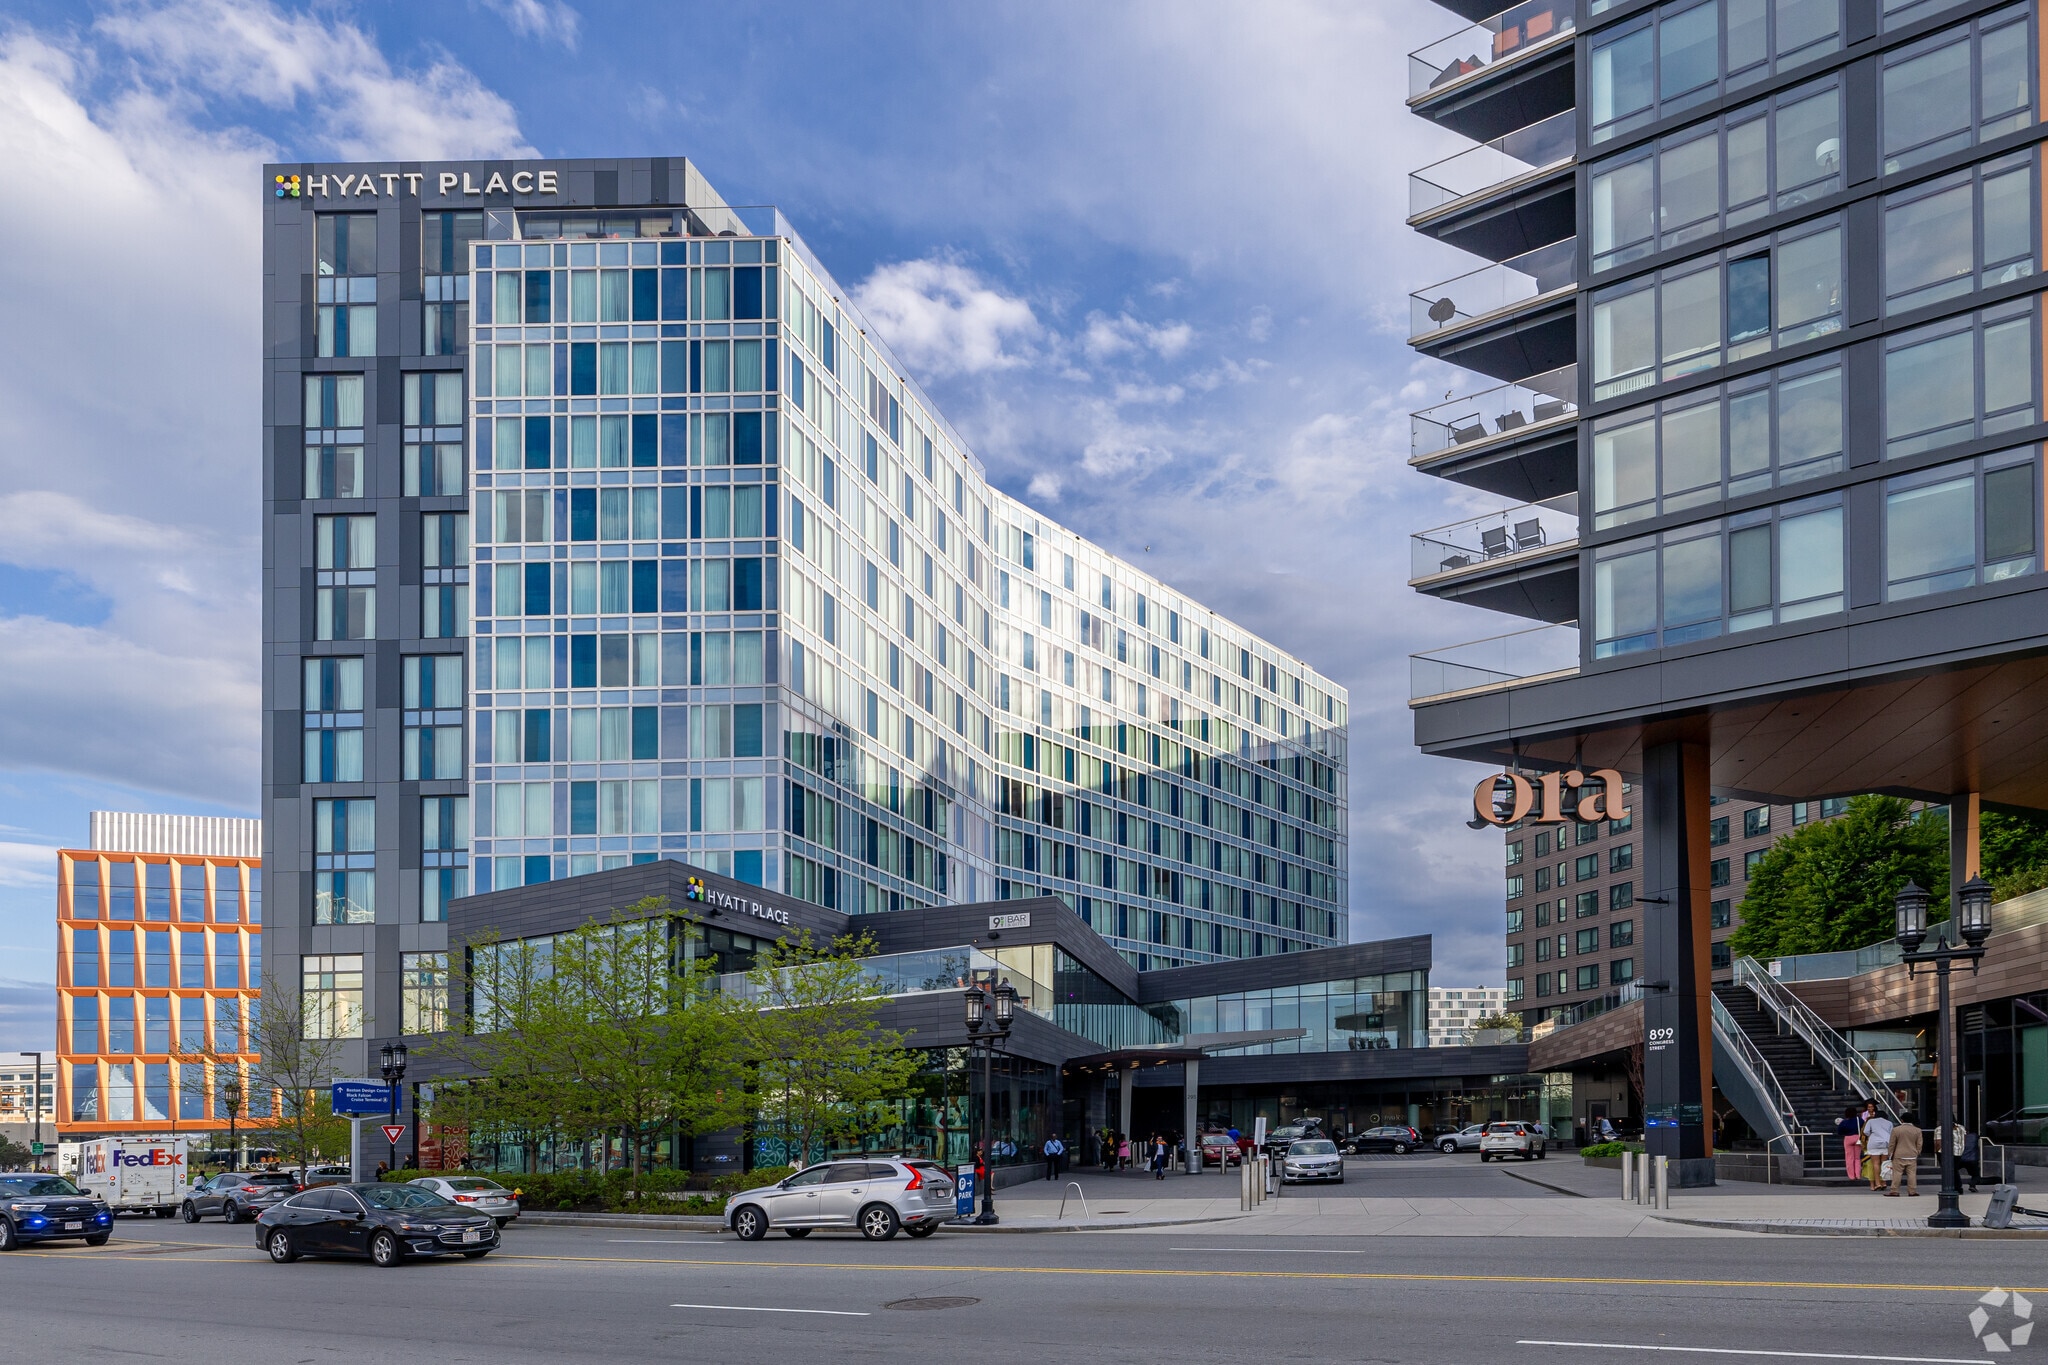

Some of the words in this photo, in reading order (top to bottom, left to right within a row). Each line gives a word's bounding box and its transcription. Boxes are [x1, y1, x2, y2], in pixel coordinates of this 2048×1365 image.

[307, 173, 423, 197] HYATT
[439, 171, 558, 195] PLACE
[1474, 768, 1630, 824] ora
[707, 889, 748, 912] HYATT
[752, 902, 789, 925] PLACE
[1007, 915, 1027, 923] BAR
[1649, 1027, 1674, 1040] 899
[86, 1144, 106, 1175] FedEx
[113, 1149, 183, 1167] FedEx
[958, 1191, 972, 1200] PARK
